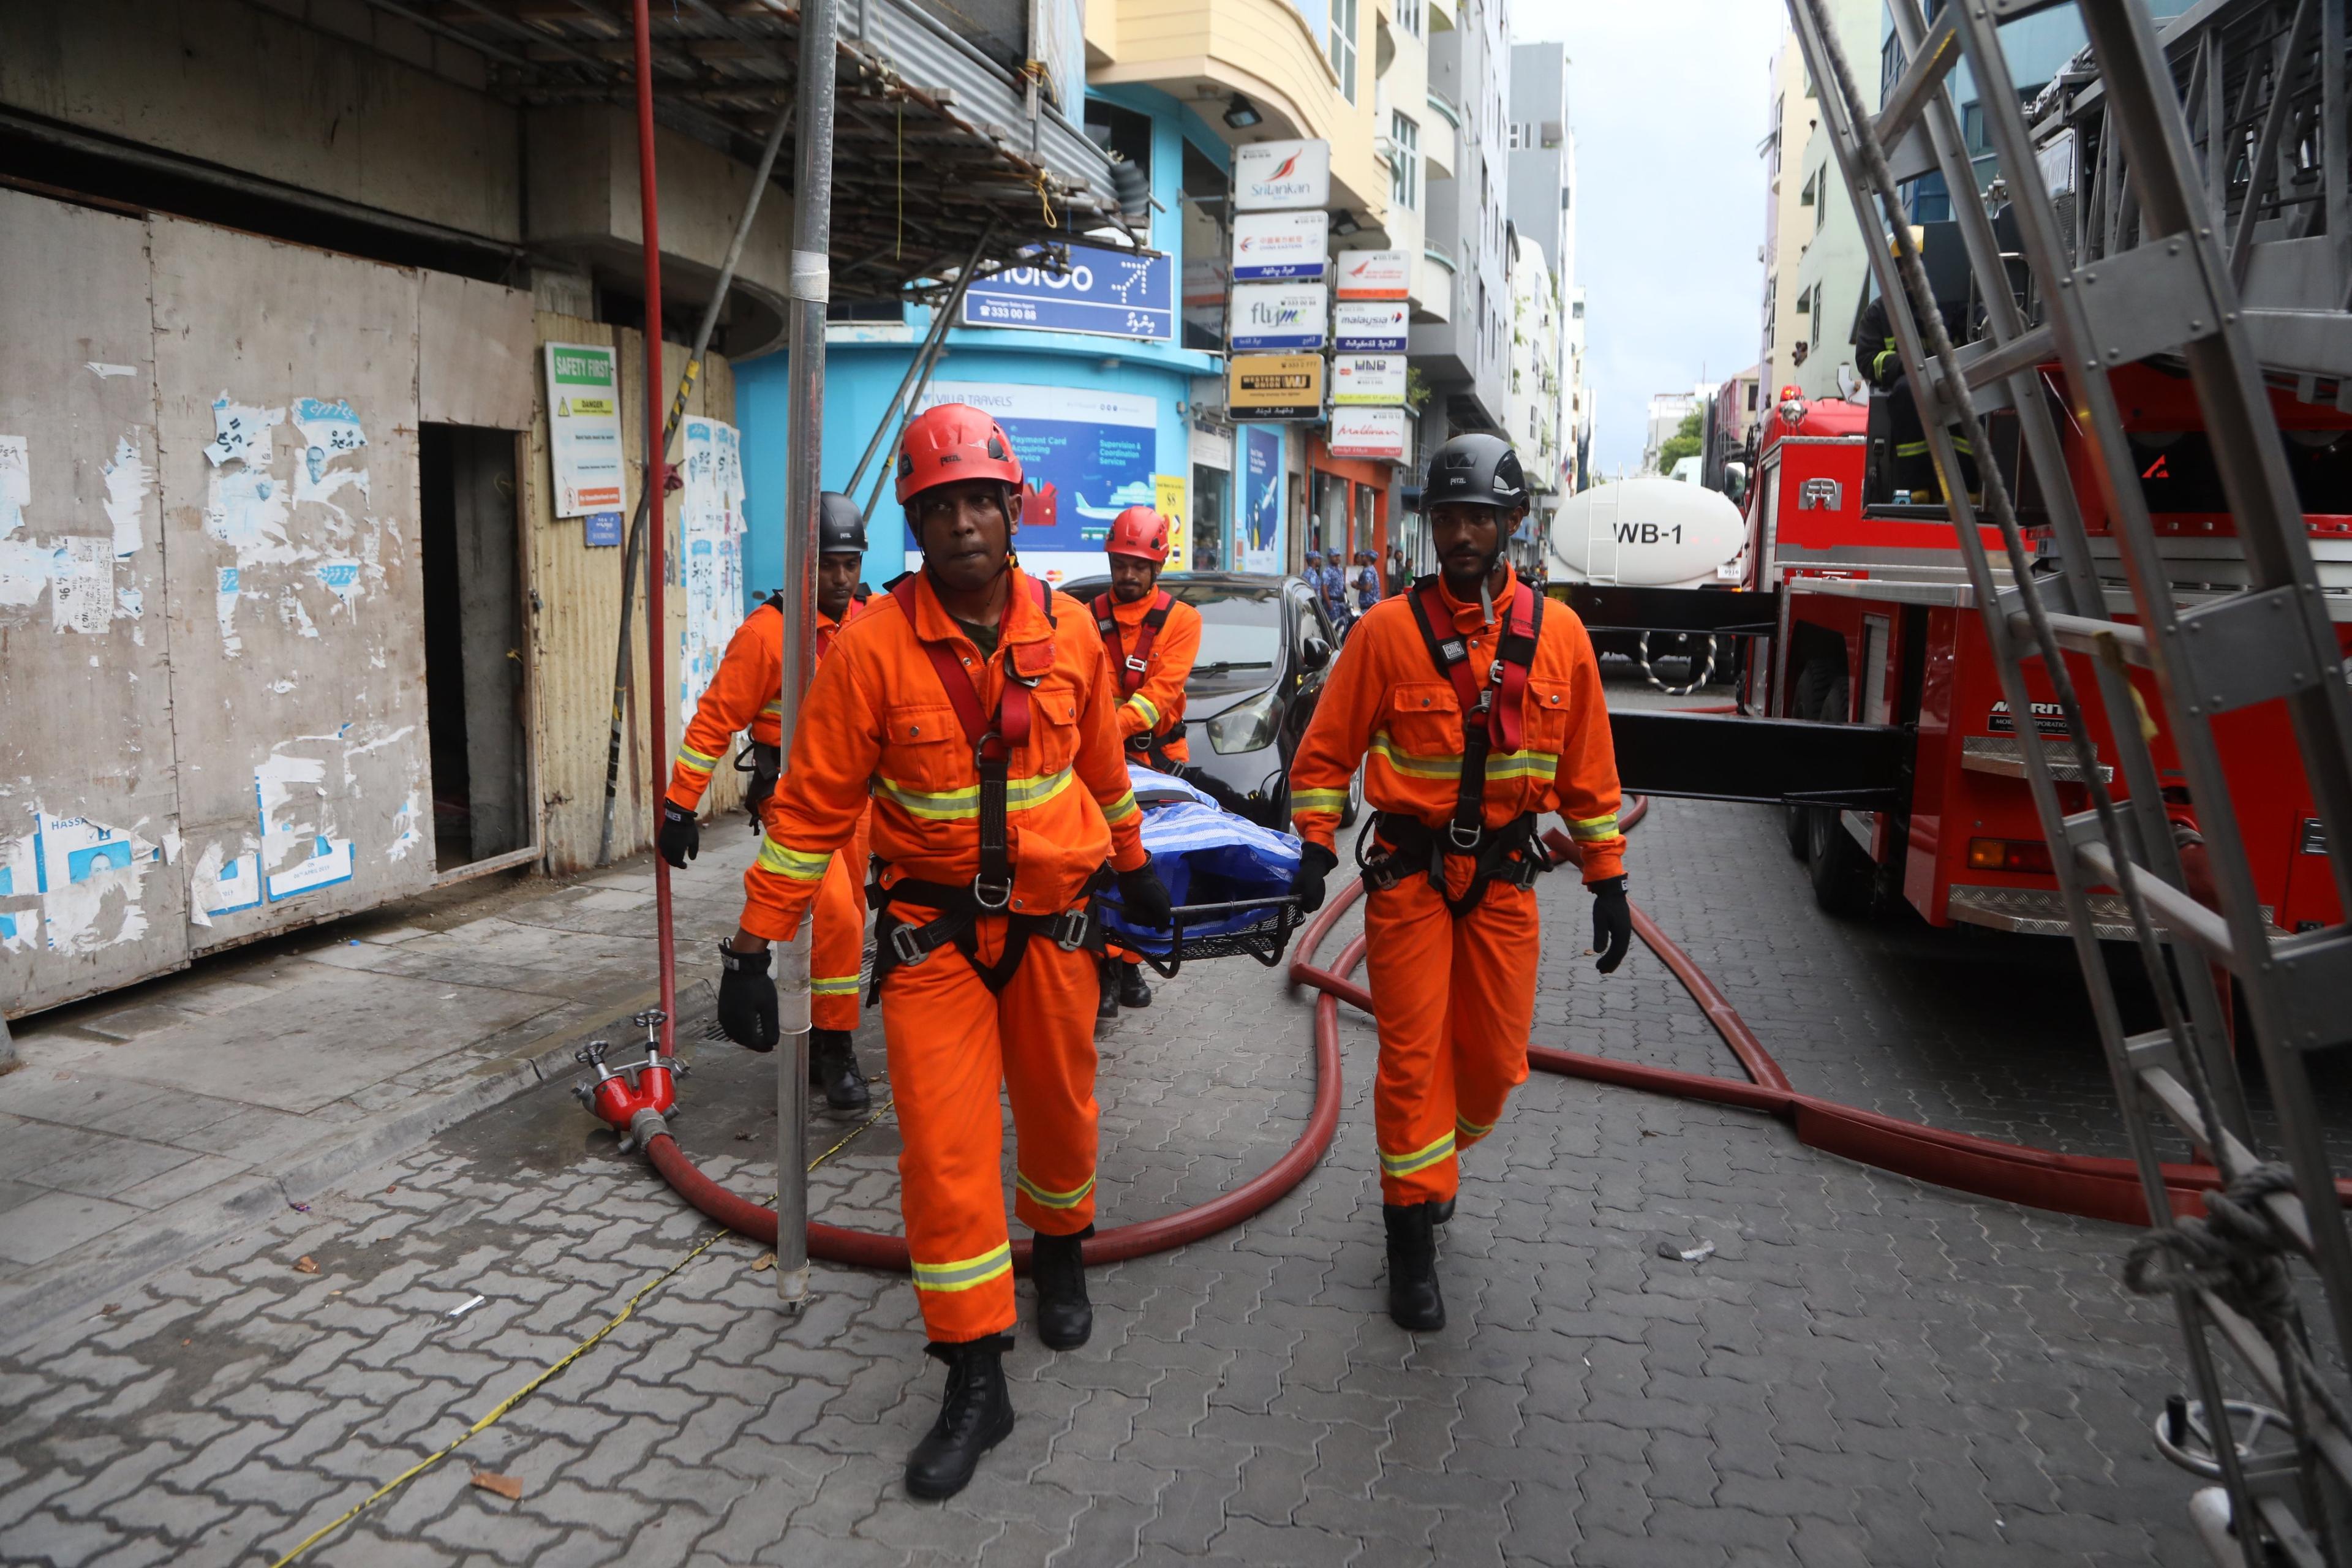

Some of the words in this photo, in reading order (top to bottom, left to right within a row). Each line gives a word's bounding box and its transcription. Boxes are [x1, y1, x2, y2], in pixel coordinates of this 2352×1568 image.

[991, 306, 1009, 318] 333
[1011, 309, 1023, 319] 00
[1341, 315, 1388, 325] malaysia
[556, 356, 586, 376] SAFETY
[587, 358, 609, 377] FIRST
[1355, 360, 1386, 371] HNB
[582, 399, 603, 408] DANGER
[936, 394, 965, 404] VILLA
[967, 394, 1012, 407] TRAVELS
[1011, 435, 1046, 444] Payment
[1048, 437, 1067, 445] Card
[1099, 440, 1136, 449] Supervision
[1011, 445, 1050, 454] Acquiring
[1099, 448, 1139, 458] Coordination
[1613, 523, 1681, 544] WB-1
[1446, 643, 1461, 655] CMC
